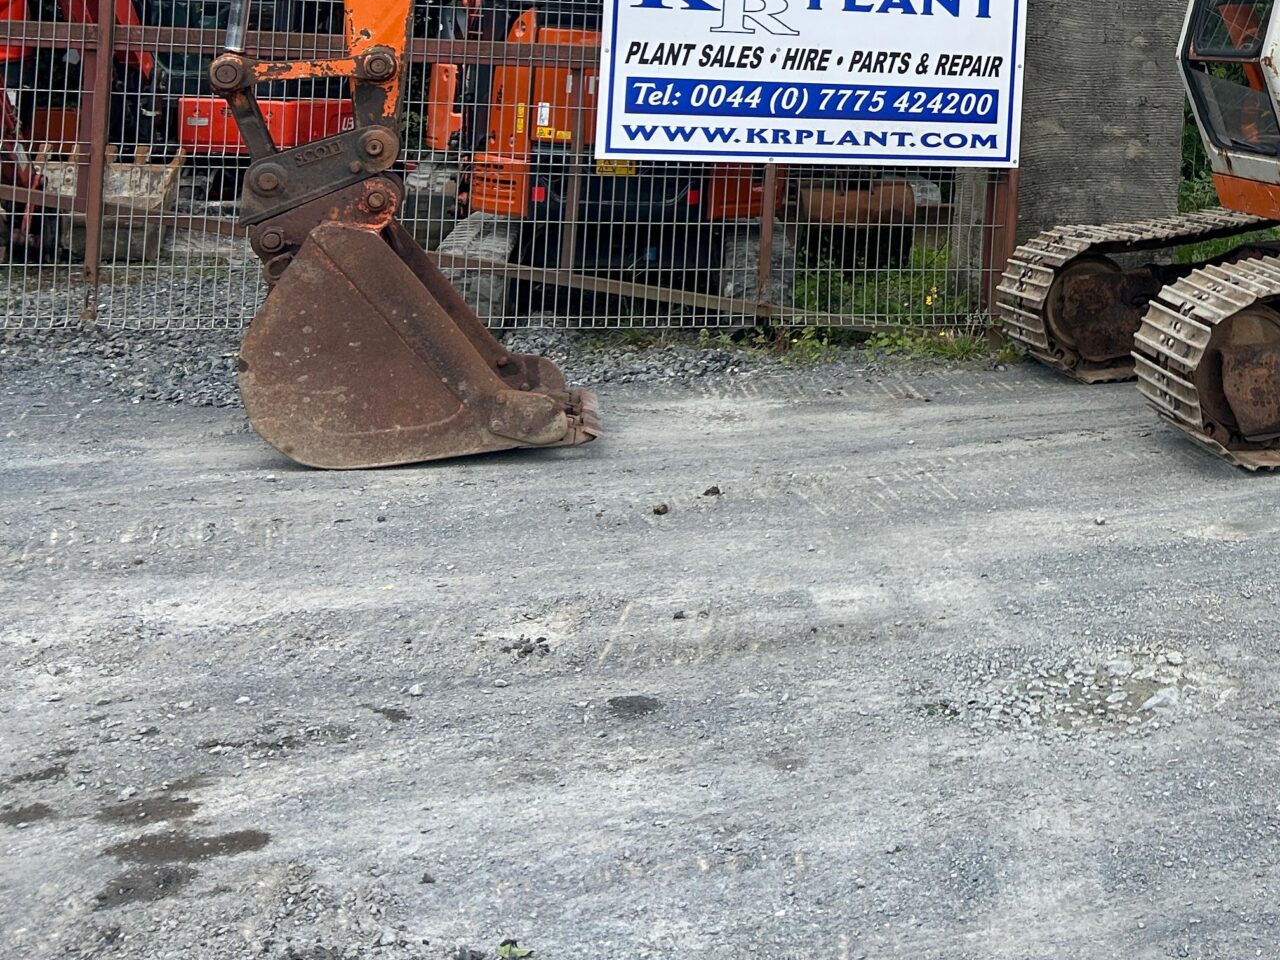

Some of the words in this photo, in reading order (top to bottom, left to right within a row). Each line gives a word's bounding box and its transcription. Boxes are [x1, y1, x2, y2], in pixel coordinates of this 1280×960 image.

[625, 41, 696, 66] PLANT
[698, 44, 765, 69] SALES
[782, 48, 833, 72] HIRE
[848, 51, 911, 75] PARTS
[915, 55, 929, 75] &
[934, 54, 1003, 78] REPAIR
[631, 82, 681, 107] Tel:
[690, 84, 761, 109] 0044
[769, 86, 809, 115] (0)
[819, 89, 886, 113] 7775
[893, 92, 993, 116] 424200
[621, 125, 998, 149] WWW.KRPLANT.COM
